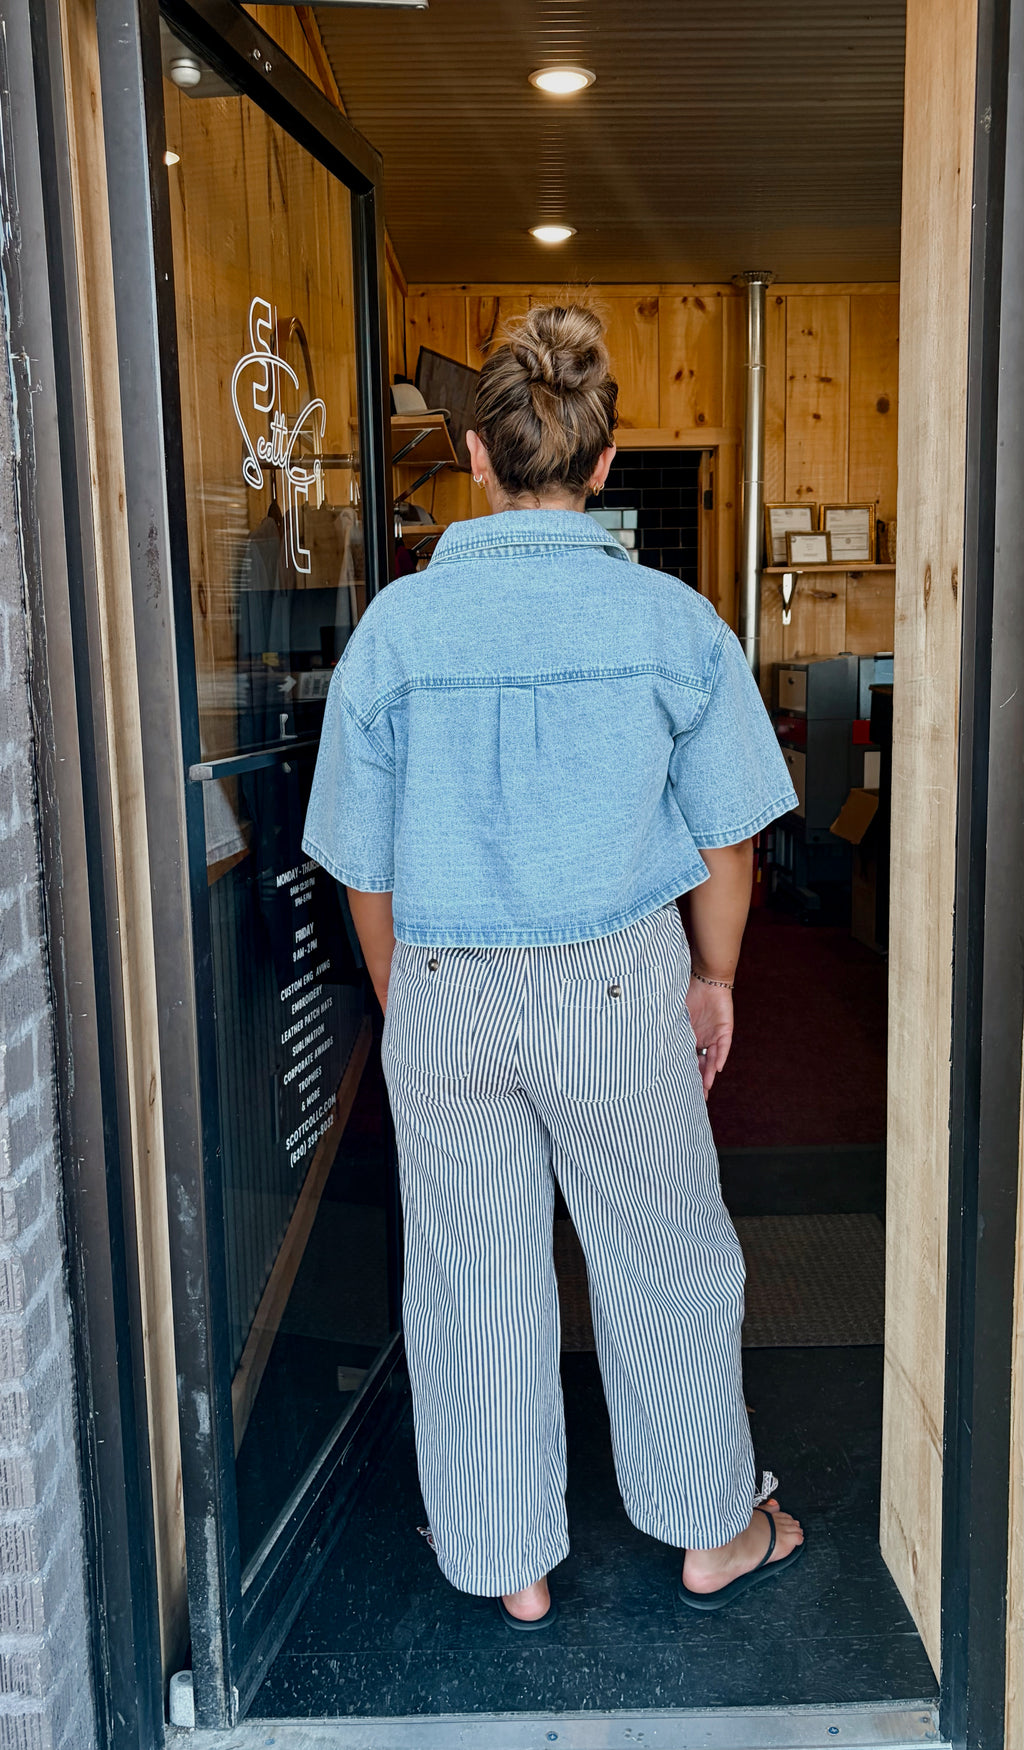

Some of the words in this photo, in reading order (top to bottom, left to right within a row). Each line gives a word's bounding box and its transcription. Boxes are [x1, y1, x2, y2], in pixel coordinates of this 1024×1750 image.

[276, 866, 299, 888] MONDAY
[295, 921, 314, 944] FRIDAY
[280, 977, 303, 1002] CUSTOM
[281, 1019, 304, 1044] LEATHER
[304, 1006, 320, 1026] PATCH
[283, 1052, 314, 1086] CORPORATE
[314, 1035, 334, 1060] AWARDS
[298, 1065, 322, 1094] TROPHIES
[301, 1101, 306, 1112] &
[306, 1087, 321, 1108] MORE
[285, 1092, 337, 1151] SCOTTCOLLC.COM
